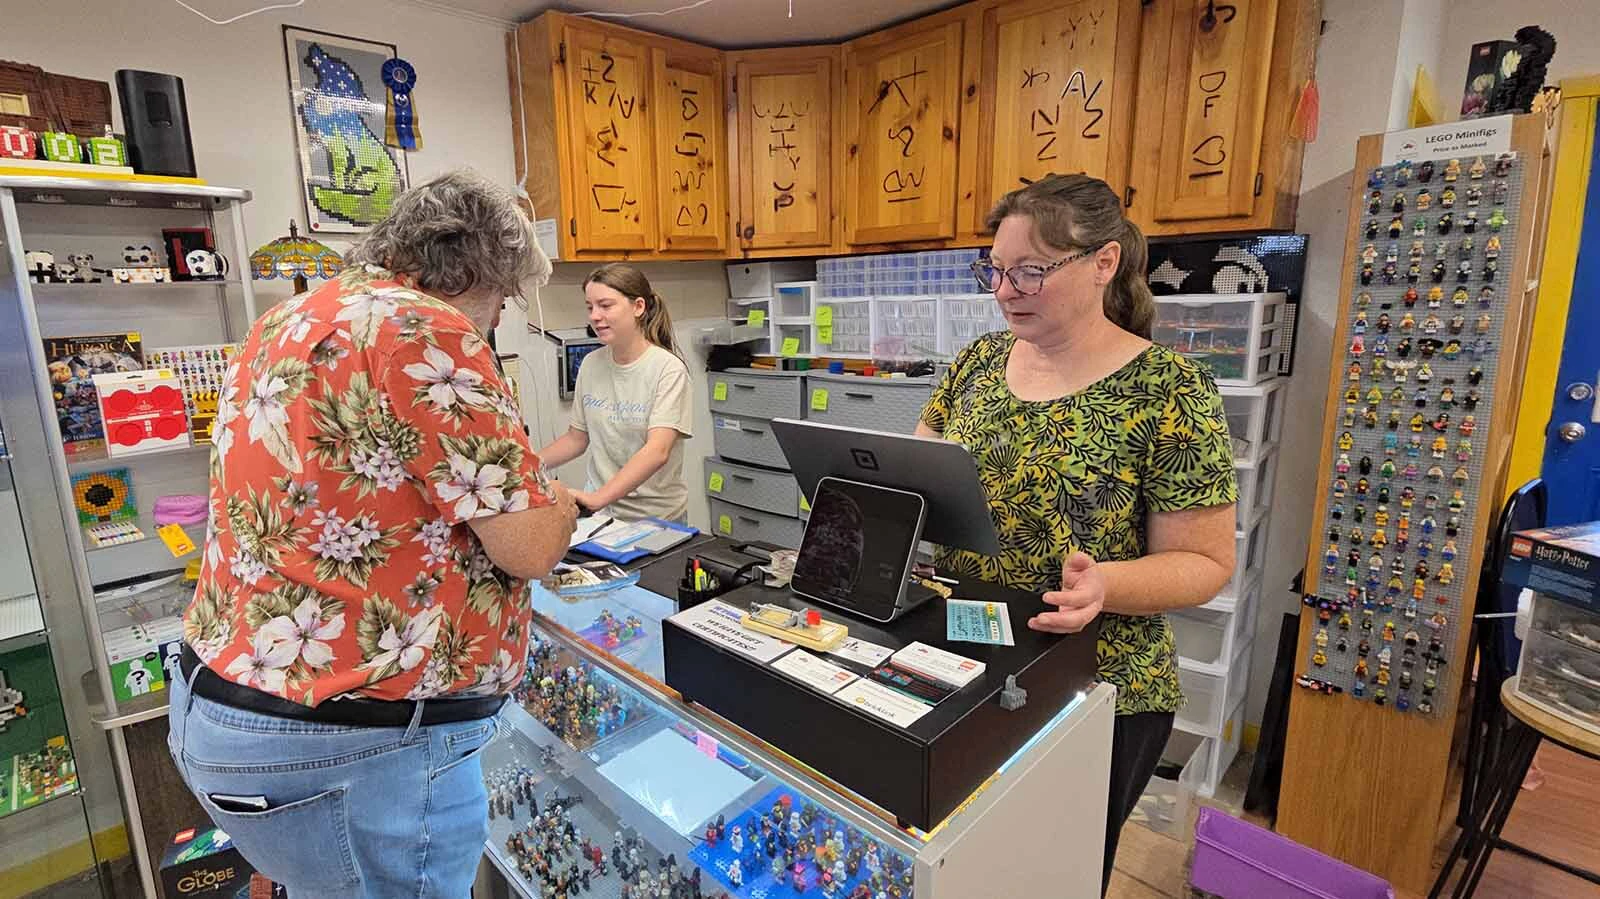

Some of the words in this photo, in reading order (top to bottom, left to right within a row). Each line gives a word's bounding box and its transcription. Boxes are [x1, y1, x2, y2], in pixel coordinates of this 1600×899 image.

[1425, 133, 1453, 144] LEGO
[1455, 127, 1497, 140] Minifigs
[1535, 545, 1561, 560] Harry
[1561, 550, 1590, 570] Potter
[176, 867, 236, 893] GLOBE
